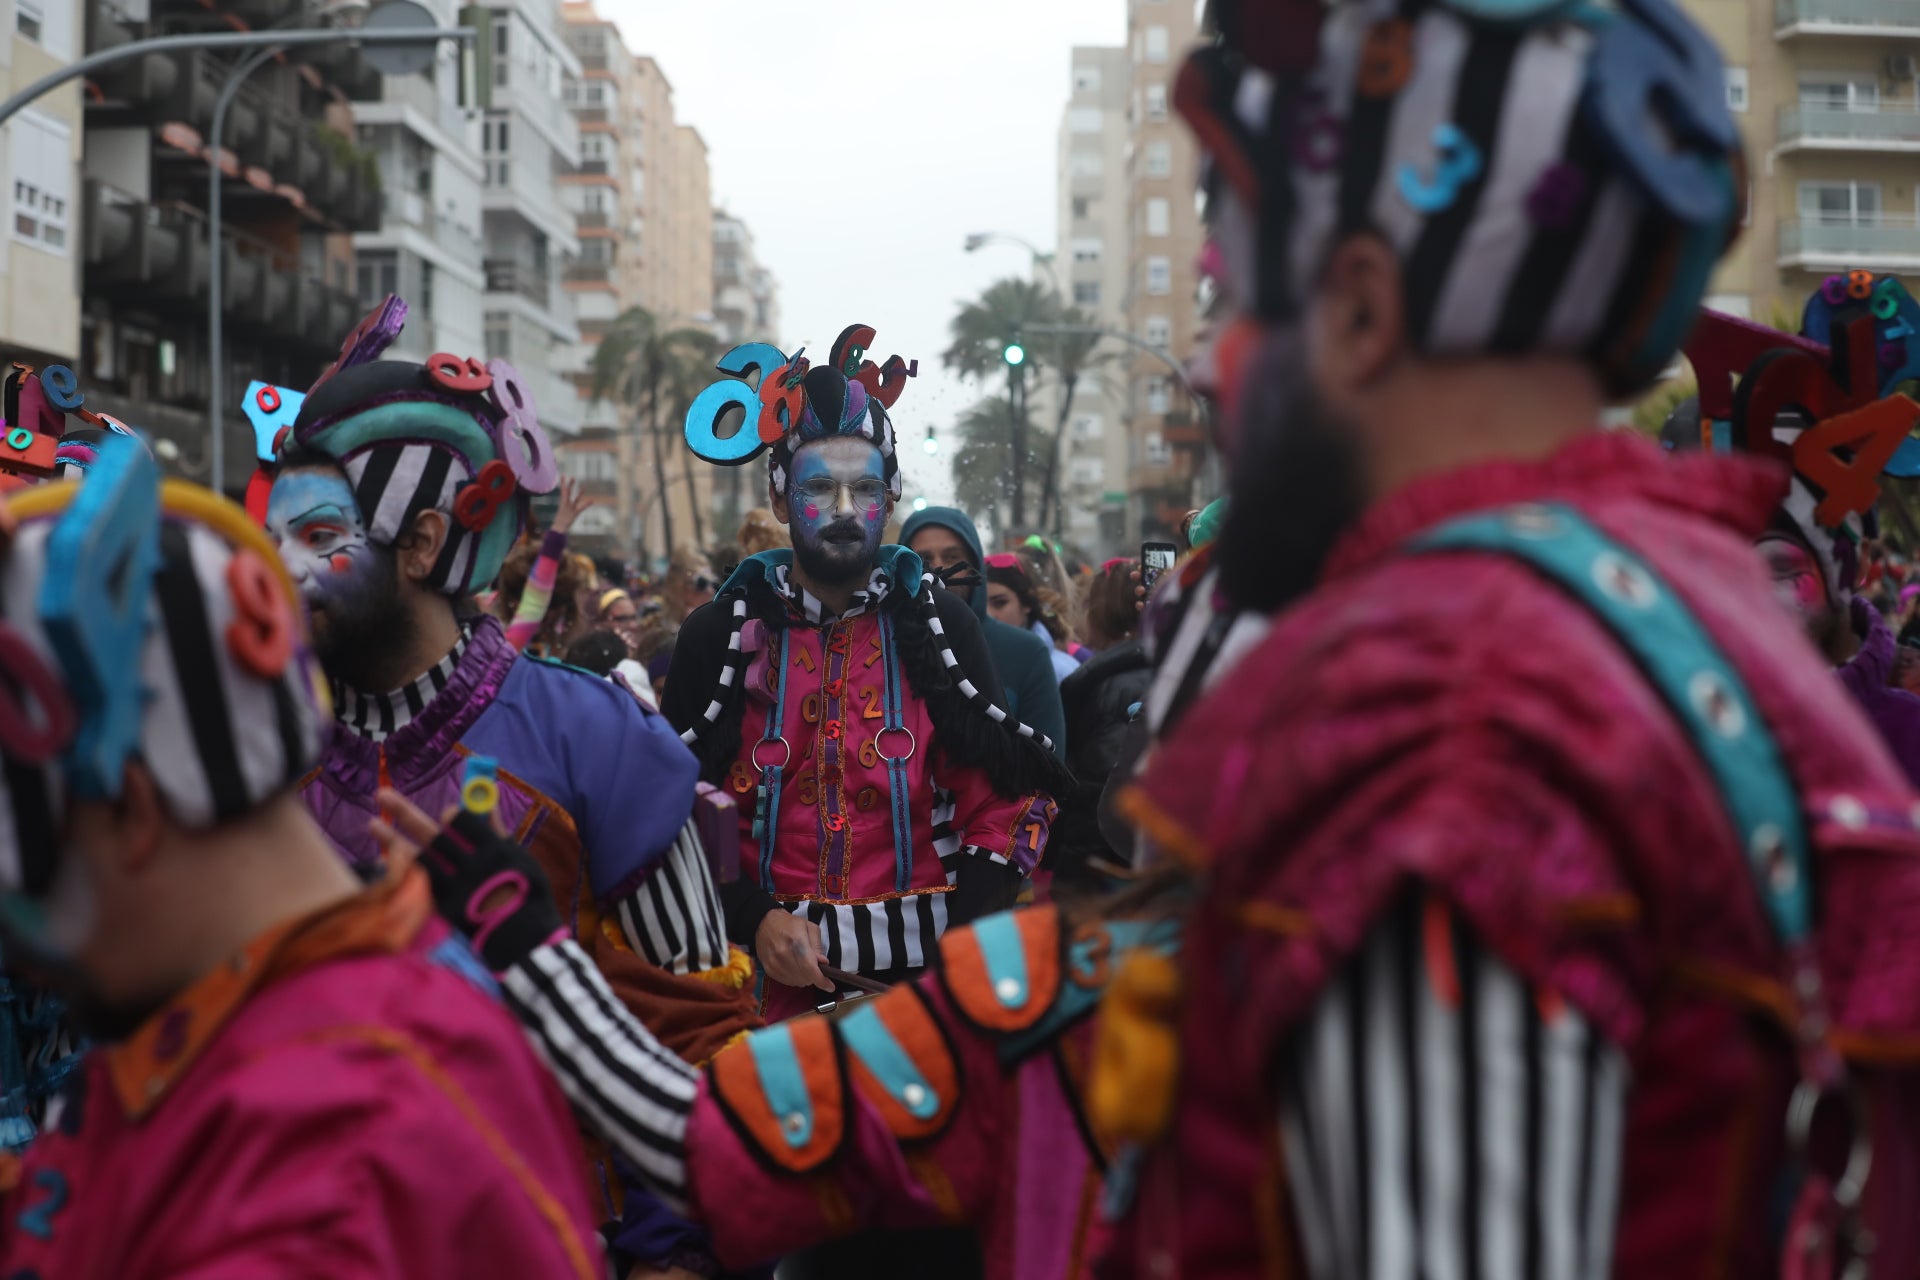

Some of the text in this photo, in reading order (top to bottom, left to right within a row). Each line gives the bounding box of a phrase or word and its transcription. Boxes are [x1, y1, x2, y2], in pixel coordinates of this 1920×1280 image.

[1848, 270, 1873, 299] 8
[455, 459, 516, 532] 8
[830, 633, 848, 654] 2
[802, 694, 821, 723] 0
[859, 685, 883, 719] 2
[825, 719, 842, 740] 6
[858, 738, 878, 768] 6
[731, 762, 753, 793] 8
[798, 769, 820, 806] 5
[826, 813, 845, 832] 3
[1025, 823, 1041, 851] 1
[16, 1167, 68, 1240] 2
